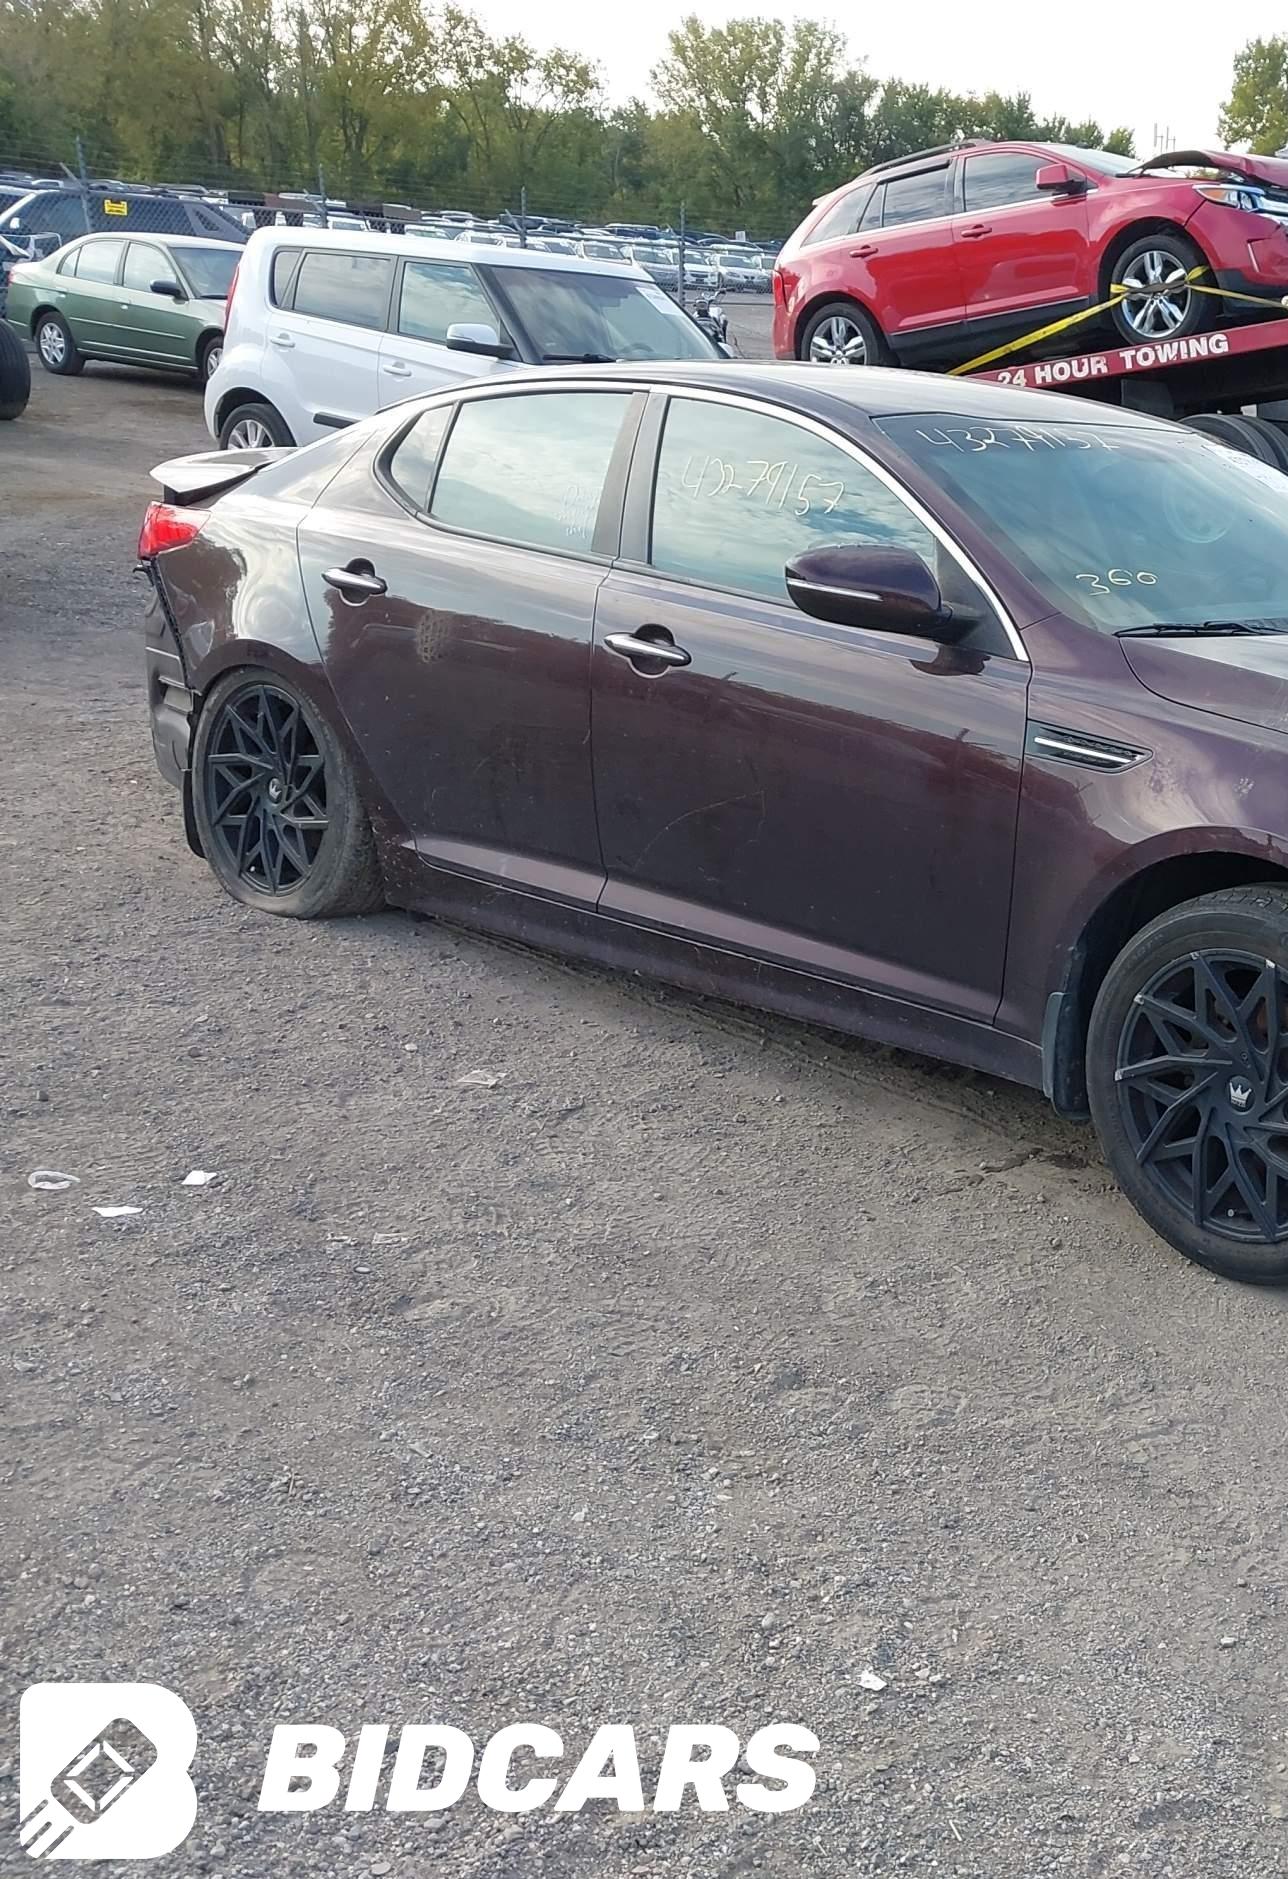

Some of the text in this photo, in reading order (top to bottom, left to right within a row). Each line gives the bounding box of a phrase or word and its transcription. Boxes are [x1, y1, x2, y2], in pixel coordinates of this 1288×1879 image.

[998, 333, 1230, 387] 24 HOUR TOWING
[1075, 568, 1159, 596] 360
